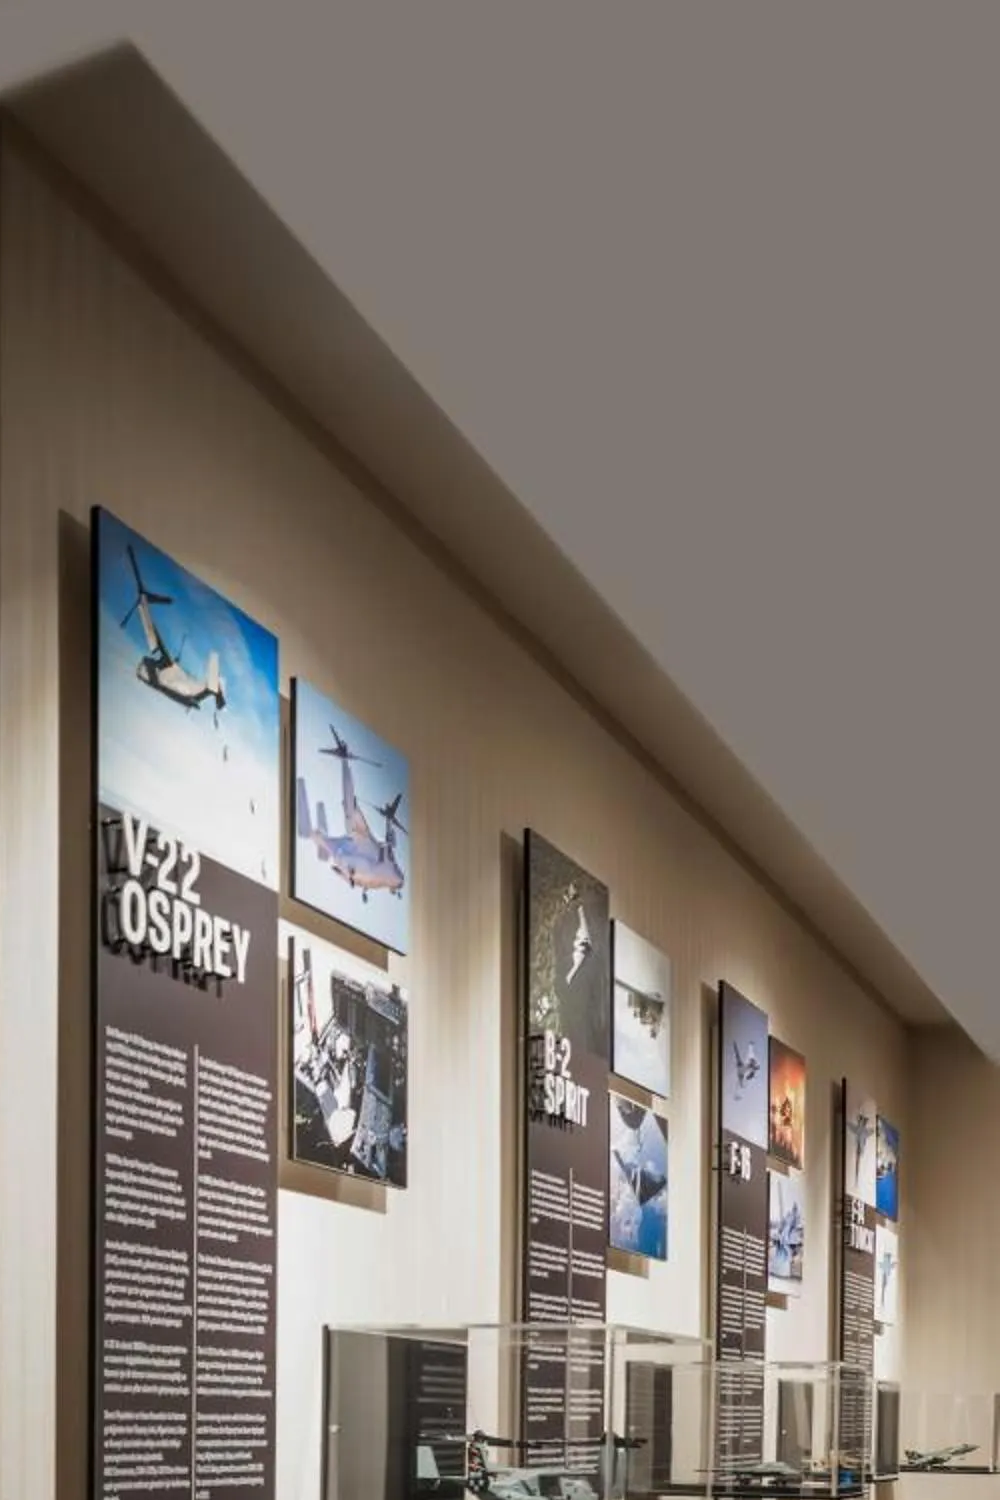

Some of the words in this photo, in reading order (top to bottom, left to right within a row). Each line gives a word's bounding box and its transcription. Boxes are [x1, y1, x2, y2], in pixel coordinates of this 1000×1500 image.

[121, 811, 201, 906] V-22
[120, 879, 251, 985] OSPREY
[544, 1030, 571, 1078] B-2
[544, 1073, 590, 1128] SPIRIT
